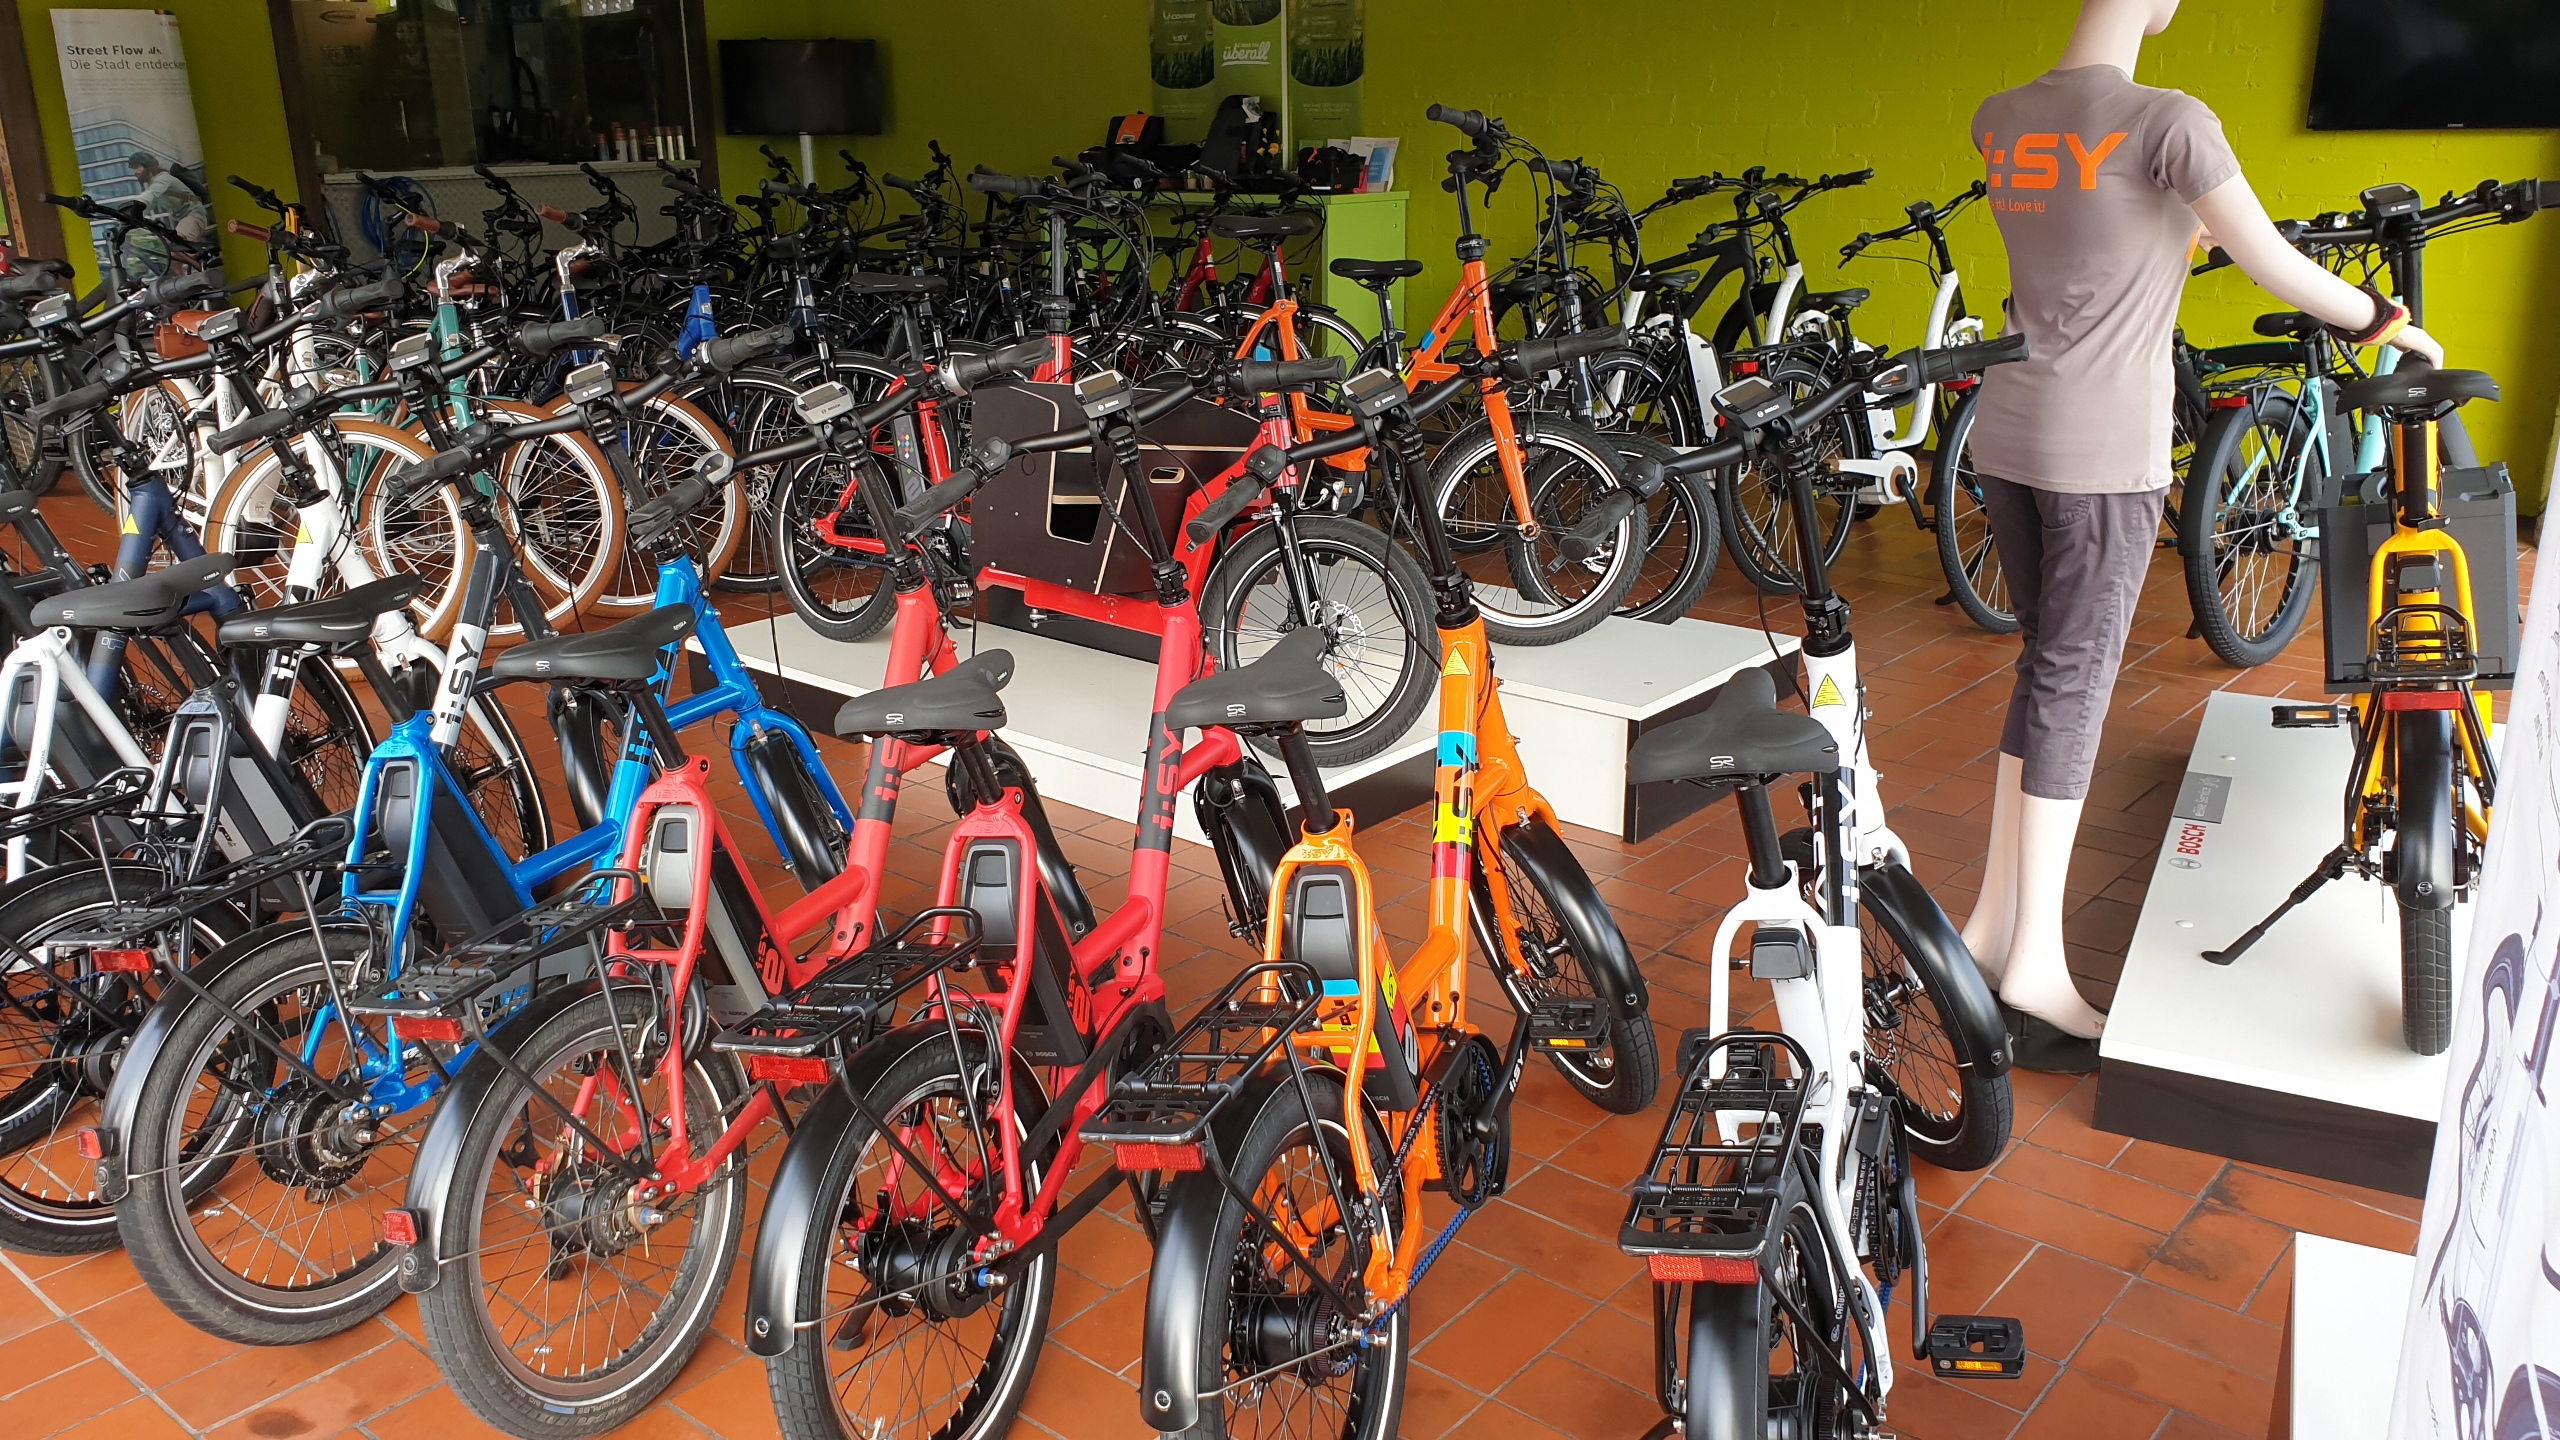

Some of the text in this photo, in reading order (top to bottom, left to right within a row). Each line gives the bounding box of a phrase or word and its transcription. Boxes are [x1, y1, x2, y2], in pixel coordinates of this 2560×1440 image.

[67, 44, 144, 56] Street Flow
[1223, 41, 1271, 61] überall
[69, 59, 92, 70] Die
[95, 58, 130, 70] Stadt
[2008, 198, 2032, 213] Love
[2033, 200, 2046, 213] it!
[440, 639, 479, 726] i:SY
[2177, 823, 2206, 856] BOSCH
